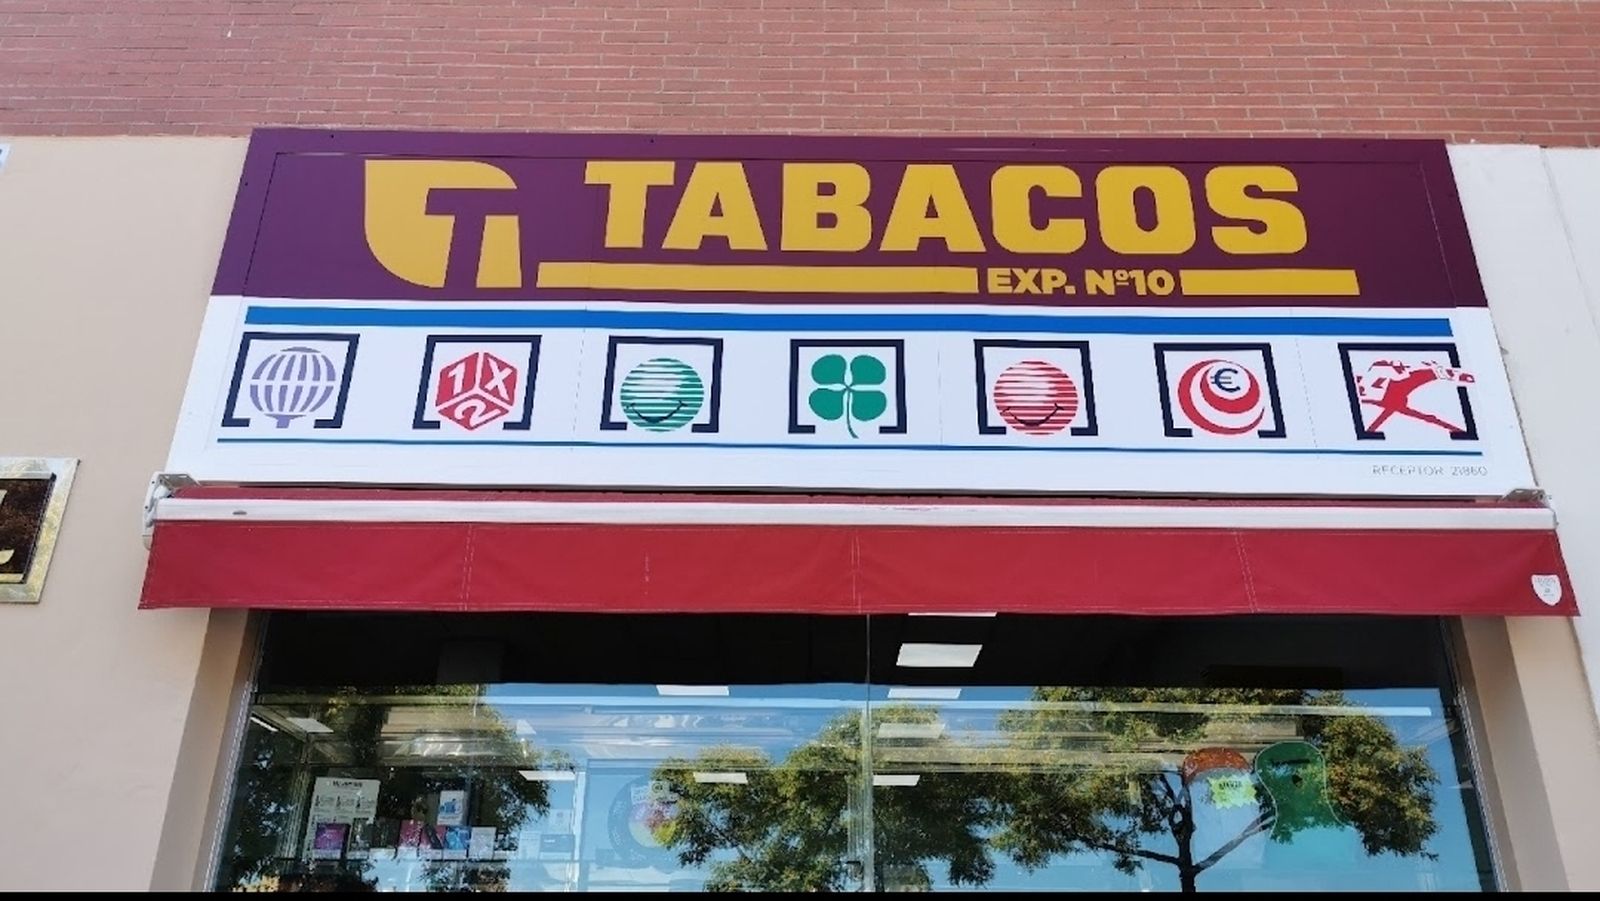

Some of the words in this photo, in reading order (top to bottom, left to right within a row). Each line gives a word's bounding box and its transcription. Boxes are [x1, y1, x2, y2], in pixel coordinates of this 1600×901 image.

[584, 160, 1308, 255] TABACOS
[987, 267, 1076, 295] EXP.
[1372, 464, 1444, 477] RECEPTOR
